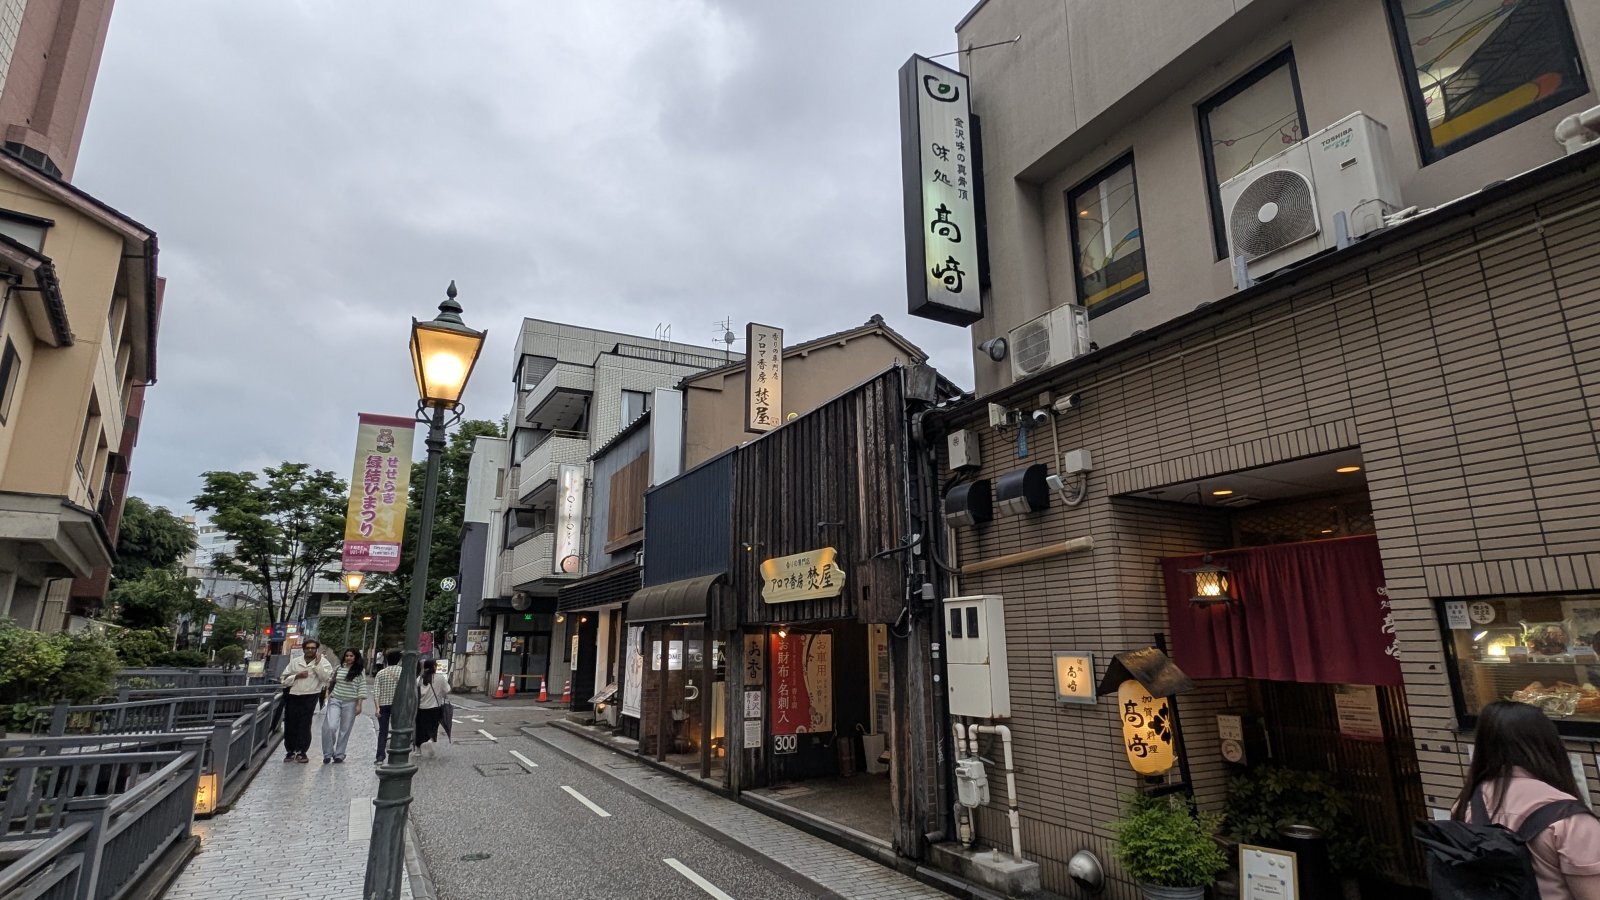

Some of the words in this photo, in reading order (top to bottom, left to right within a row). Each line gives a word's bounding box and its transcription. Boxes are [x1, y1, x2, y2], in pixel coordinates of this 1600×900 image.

[953, 116, 969, 201] 金沢味の真骨頂
[1321, 127, 1353, 147] TOSHIBA
[756, 333, 768, 384] アロマ香房
[382, 456, 399, 504] せせらぎ
[816, 639, 827, 677] お車用
[775, 735, 796, 751] 300
[1141, 695, 1160, 753] 加賀料理
